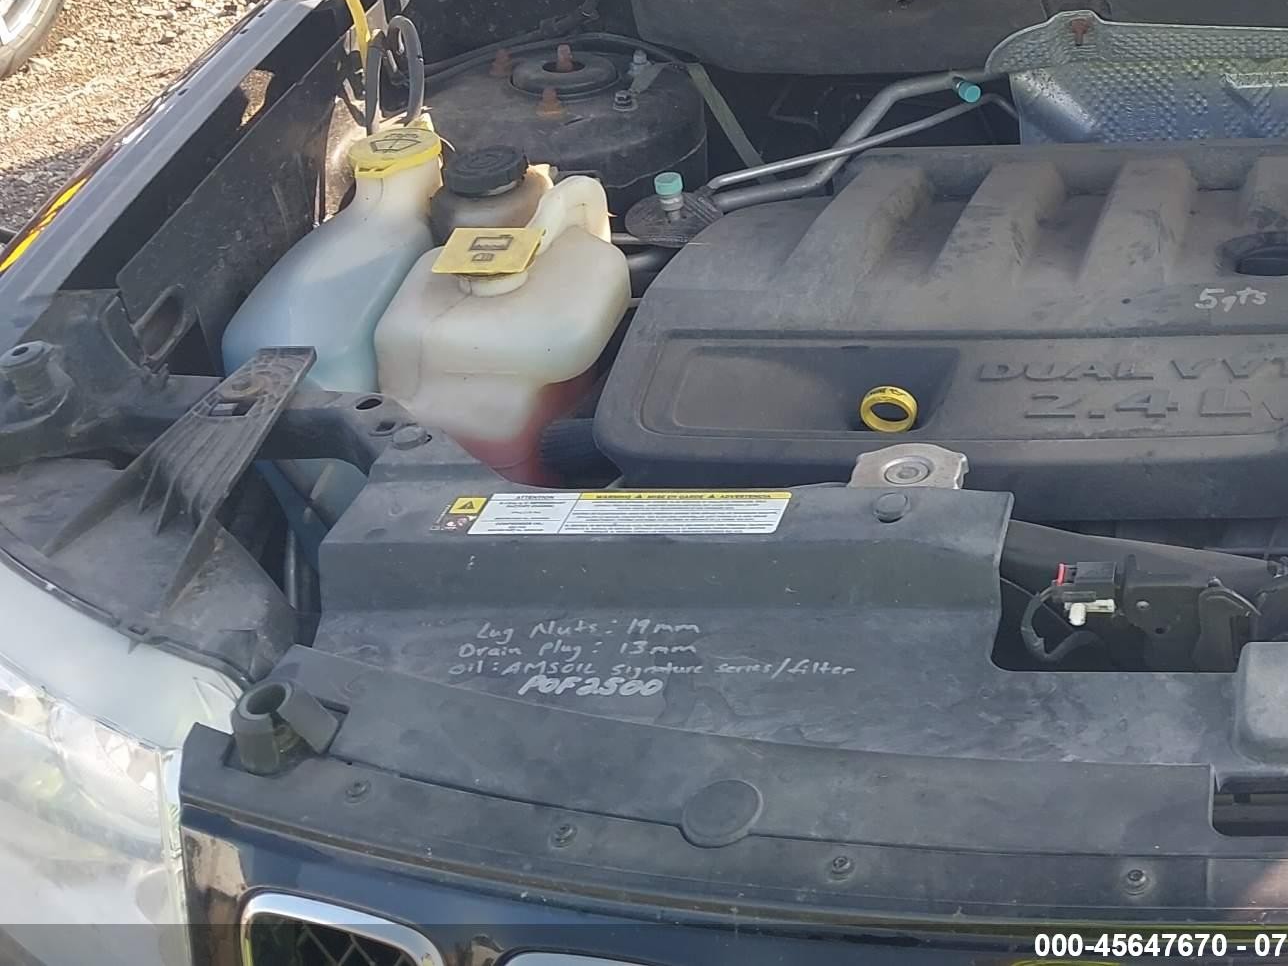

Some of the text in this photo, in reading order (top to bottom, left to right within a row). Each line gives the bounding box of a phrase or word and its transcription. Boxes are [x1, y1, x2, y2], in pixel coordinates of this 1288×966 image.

[978, 359, 1155, 382] DUAL
[1023, 389, 1253, 420] 2.4L
[476, 621, 515, 645] Lug
[458, 642, 523, 658] Drain
